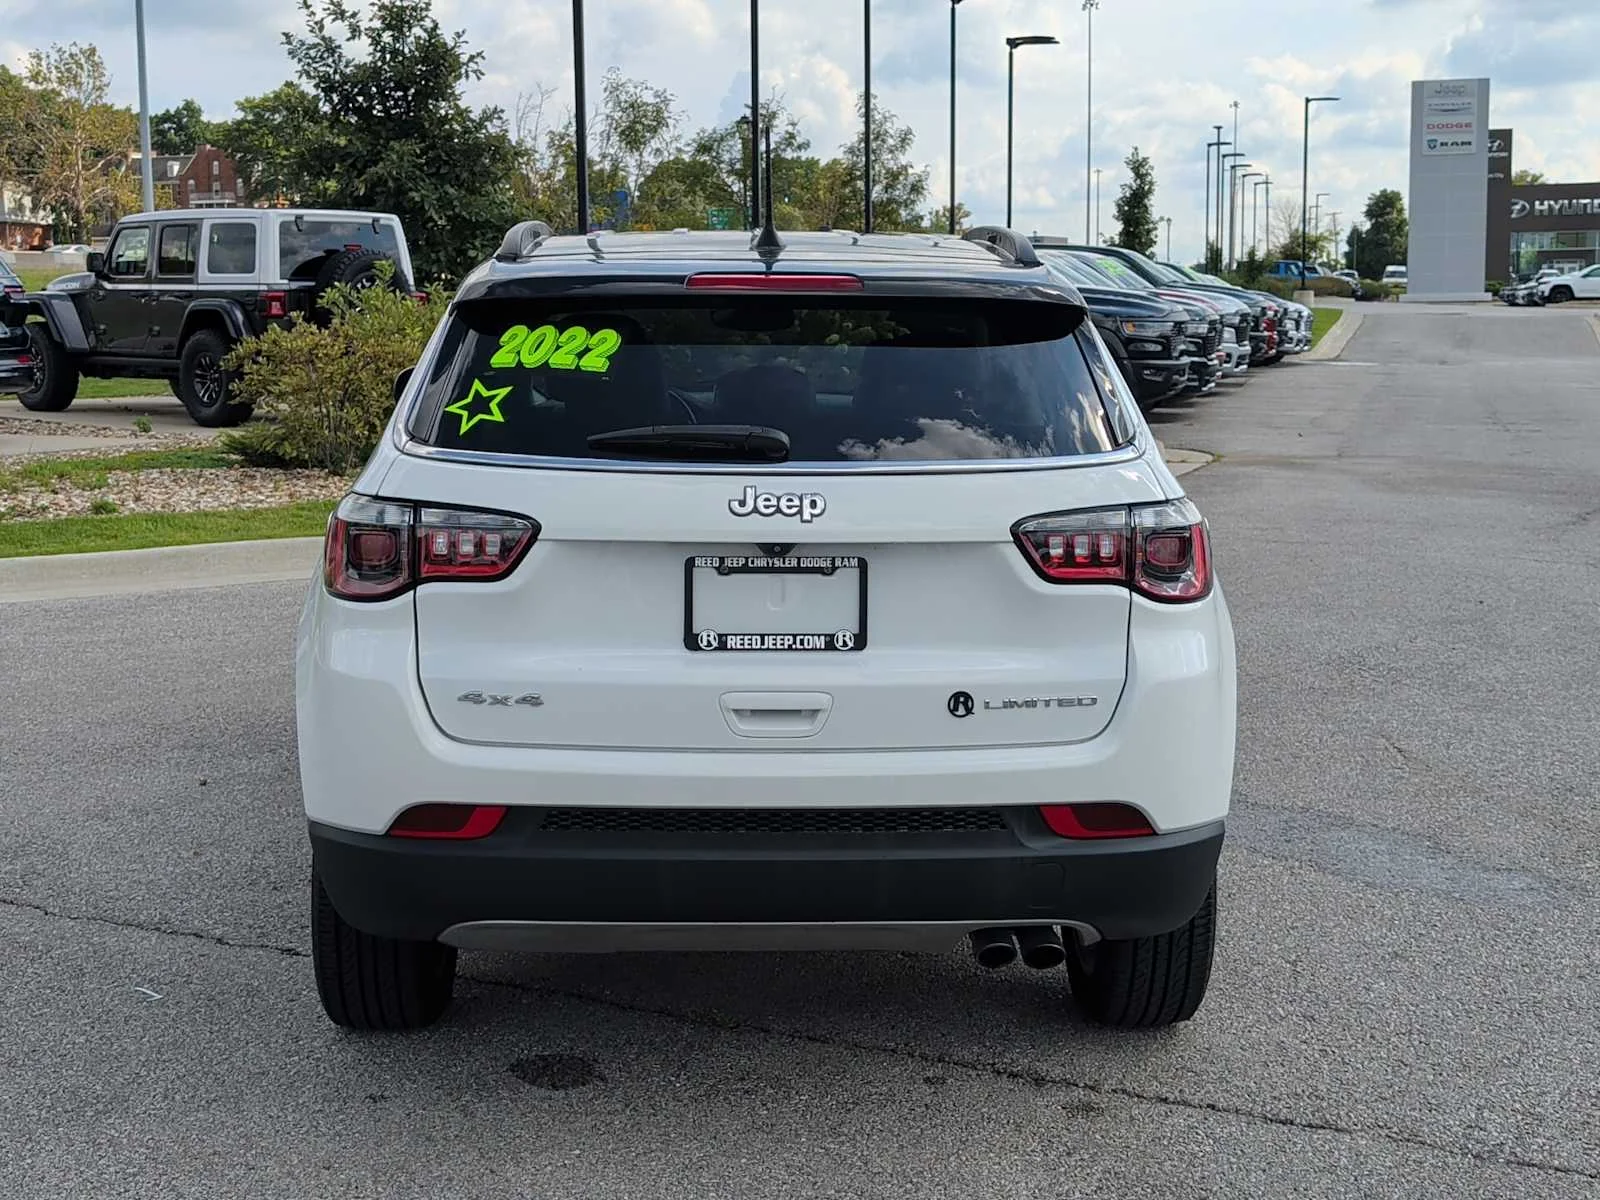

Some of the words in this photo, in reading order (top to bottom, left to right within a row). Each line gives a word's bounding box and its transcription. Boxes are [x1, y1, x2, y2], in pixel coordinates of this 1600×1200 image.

[1426, 122, 1472, 130] DODGE
[490, 325, 622, 372] 2022
[728, 485, 826, 523] Jeep
[694, 556, 720, 568] REED
[723, 556, 746, 568] JEEP
[748, 556, 798, 568] CHRYSLER
[800, 556, 833, 568] DODGE
[834, 556, 859, 568] RAM
[726, 635, 826, 650] REEDJEEP.COM
[984, 696, 1098, 710] LIMITED
